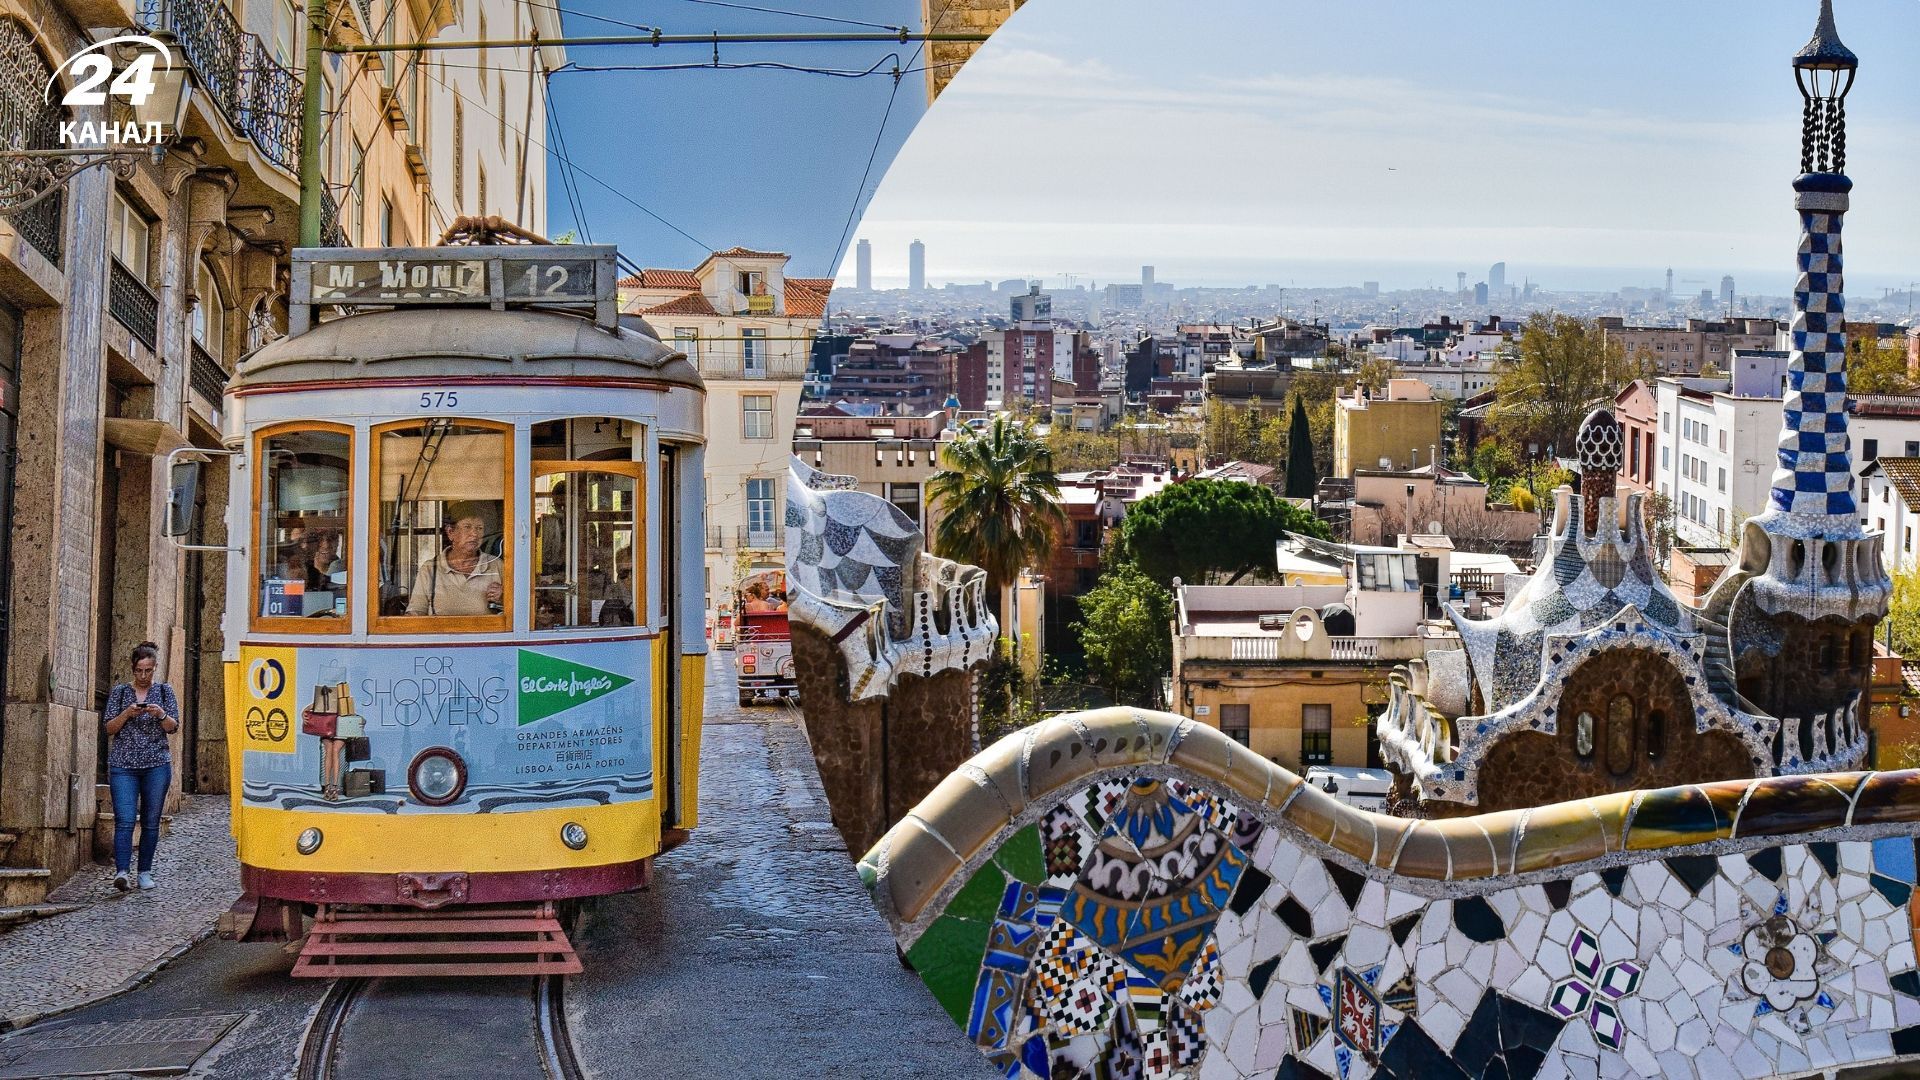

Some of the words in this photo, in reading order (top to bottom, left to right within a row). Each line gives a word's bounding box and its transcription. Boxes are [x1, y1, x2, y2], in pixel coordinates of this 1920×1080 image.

[328, 265, 366, 289] M.
[524, 264, 570, 297] 12
[419, 391, 458, 408] 575
[270, 586, 284, 595] 12E
[270, 601, 283, 614] 01
[414, 656, 454, 675] FOR
[361, 676, 509, 707] SHOPPING
[520, 676, 536, 693] El
[535, 676, 569, 693] Corte
[568, 671, 612, 697] Inglés
[380, 695, 499, 727] LOVERS
[517, 730, 568, 741] GRANDES
[517, 739, 585, 751] DEPARTMENT
[589, 735, 623, 746] STORES
[515, 764, 554, 775] LISBOA
[566, 762, 592, 771] GAIA
[595, 758, 625, 769] PORTO
